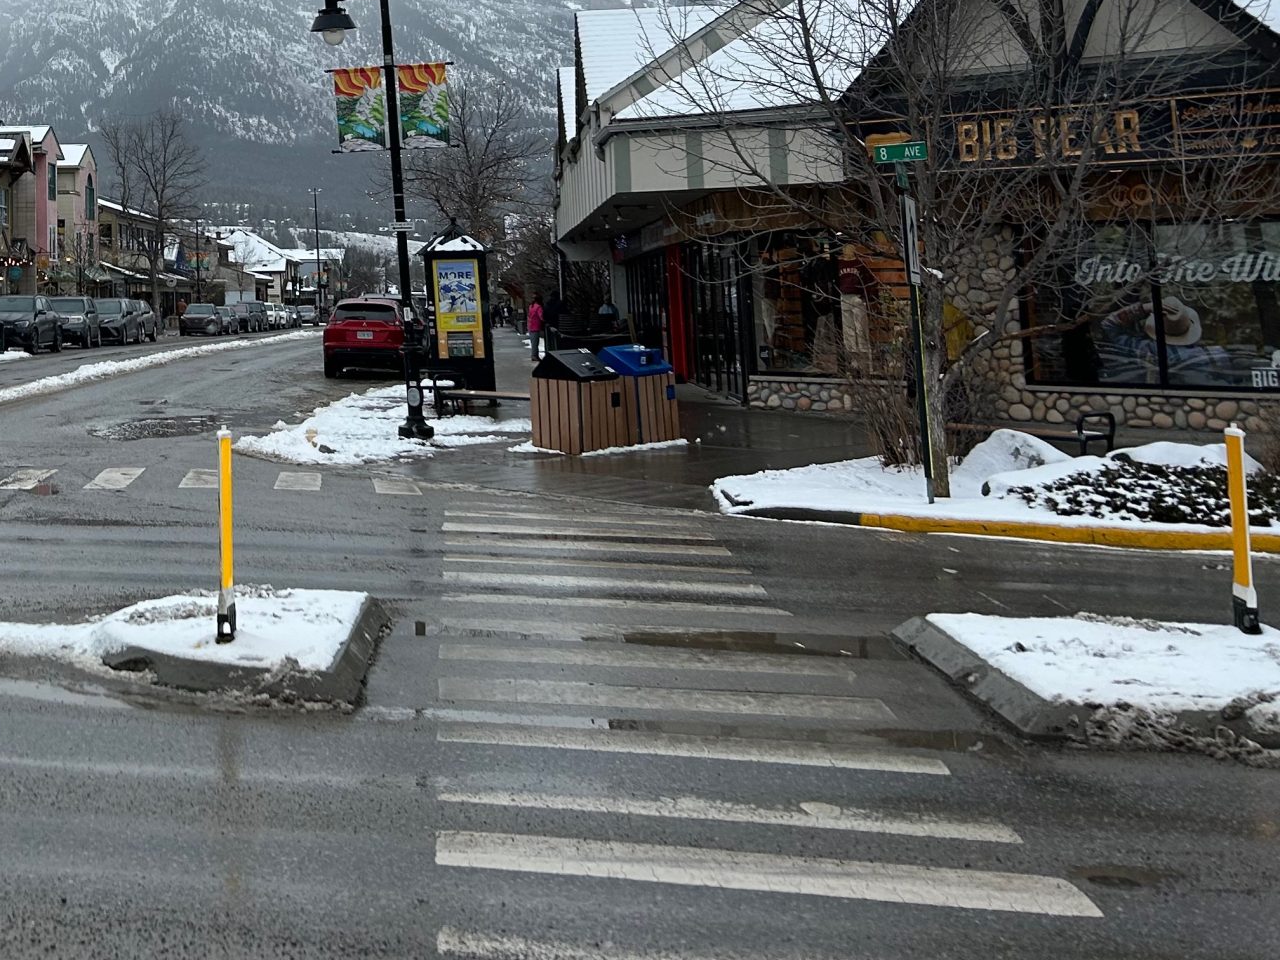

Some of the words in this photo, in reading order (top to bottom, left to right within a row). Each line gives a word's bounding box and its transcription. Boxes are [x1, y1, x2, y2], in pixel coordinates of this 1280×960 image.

[957, 118, 1018, 162] BIG
[880, 147, 888, 160] 8
[904, 148, 921, 157] AVE
[438, 271, 472, 280] MORE
[1075, 254, 1142, 286] Into
[1251, 370, 1279, 388] BIG
